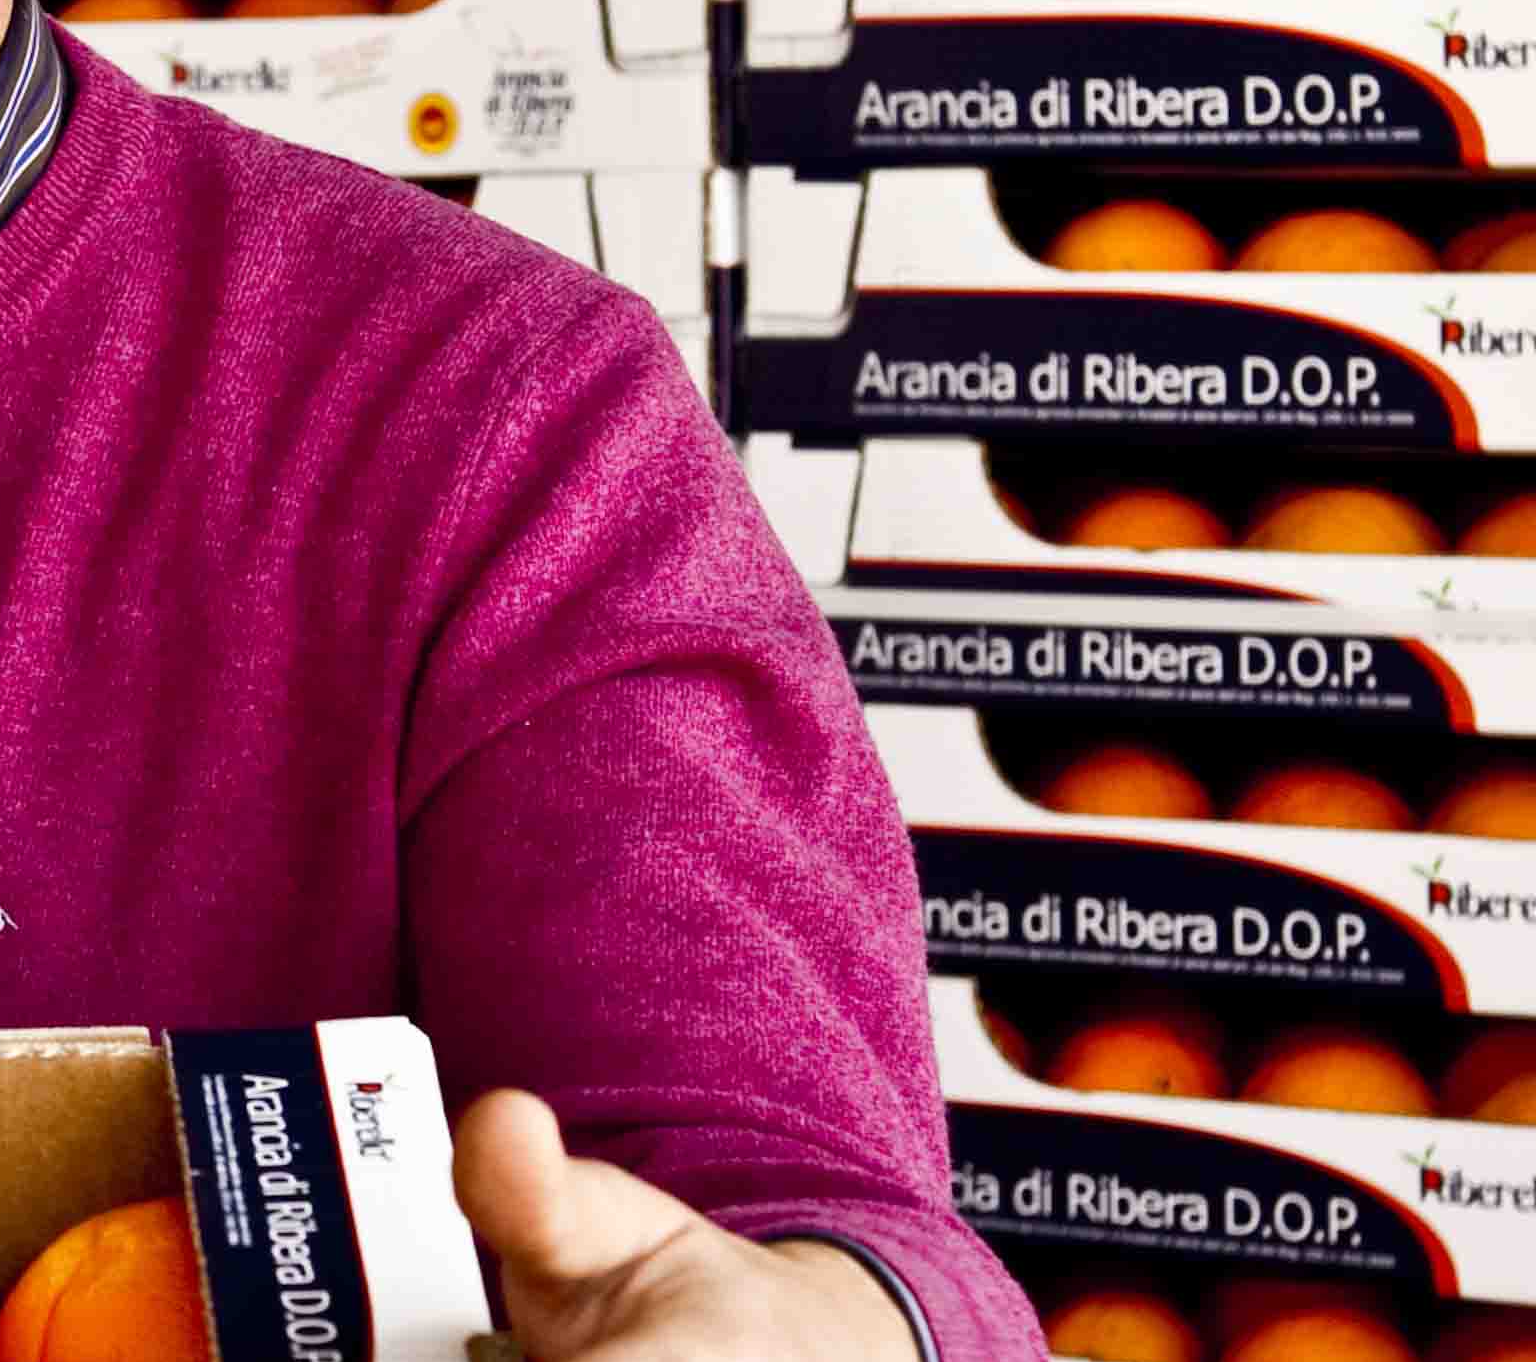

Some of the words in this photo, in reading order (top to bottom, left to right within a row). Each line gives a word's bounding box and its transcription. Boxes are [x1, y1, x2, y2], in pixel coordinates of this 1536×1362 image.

[856, 81, 1017, 129] Arancia
[1030, 79, 1070, 128] di
[1085, 77, 1228, 128] Ribera
[1245, 73, 1384, 126] D.O.P.
[856, 352, 1016, 402] Arancia
[1029, 352, 1068, 402] di
[1084, 353, 1226, 405] Ribera
[1243, 355, 1380, 407] D.O.P.
[854, 627, 1013, 676] Arancia
[1027, 630, 1065, 678] di
[1081, 630, 1223, 684] Ribera
[1239, 636, 1376, 689] D.O.P.
[1022, 895, 1061, 943] di
[1076, 897, 1217, 953] Ribera
[1233, 907, 1370, 962] D.O.P.
[242, 1073, 302, 1167] Arancia
[258, 1171, 310, 1196] di
[1013, 1169, 1052, 1216] di
[1068, 1172, 1208, 1232] Ribera
[1224, 1187, 1361, 1246] D.O.P.
[264, 1200, 318, 1285] Ribera
